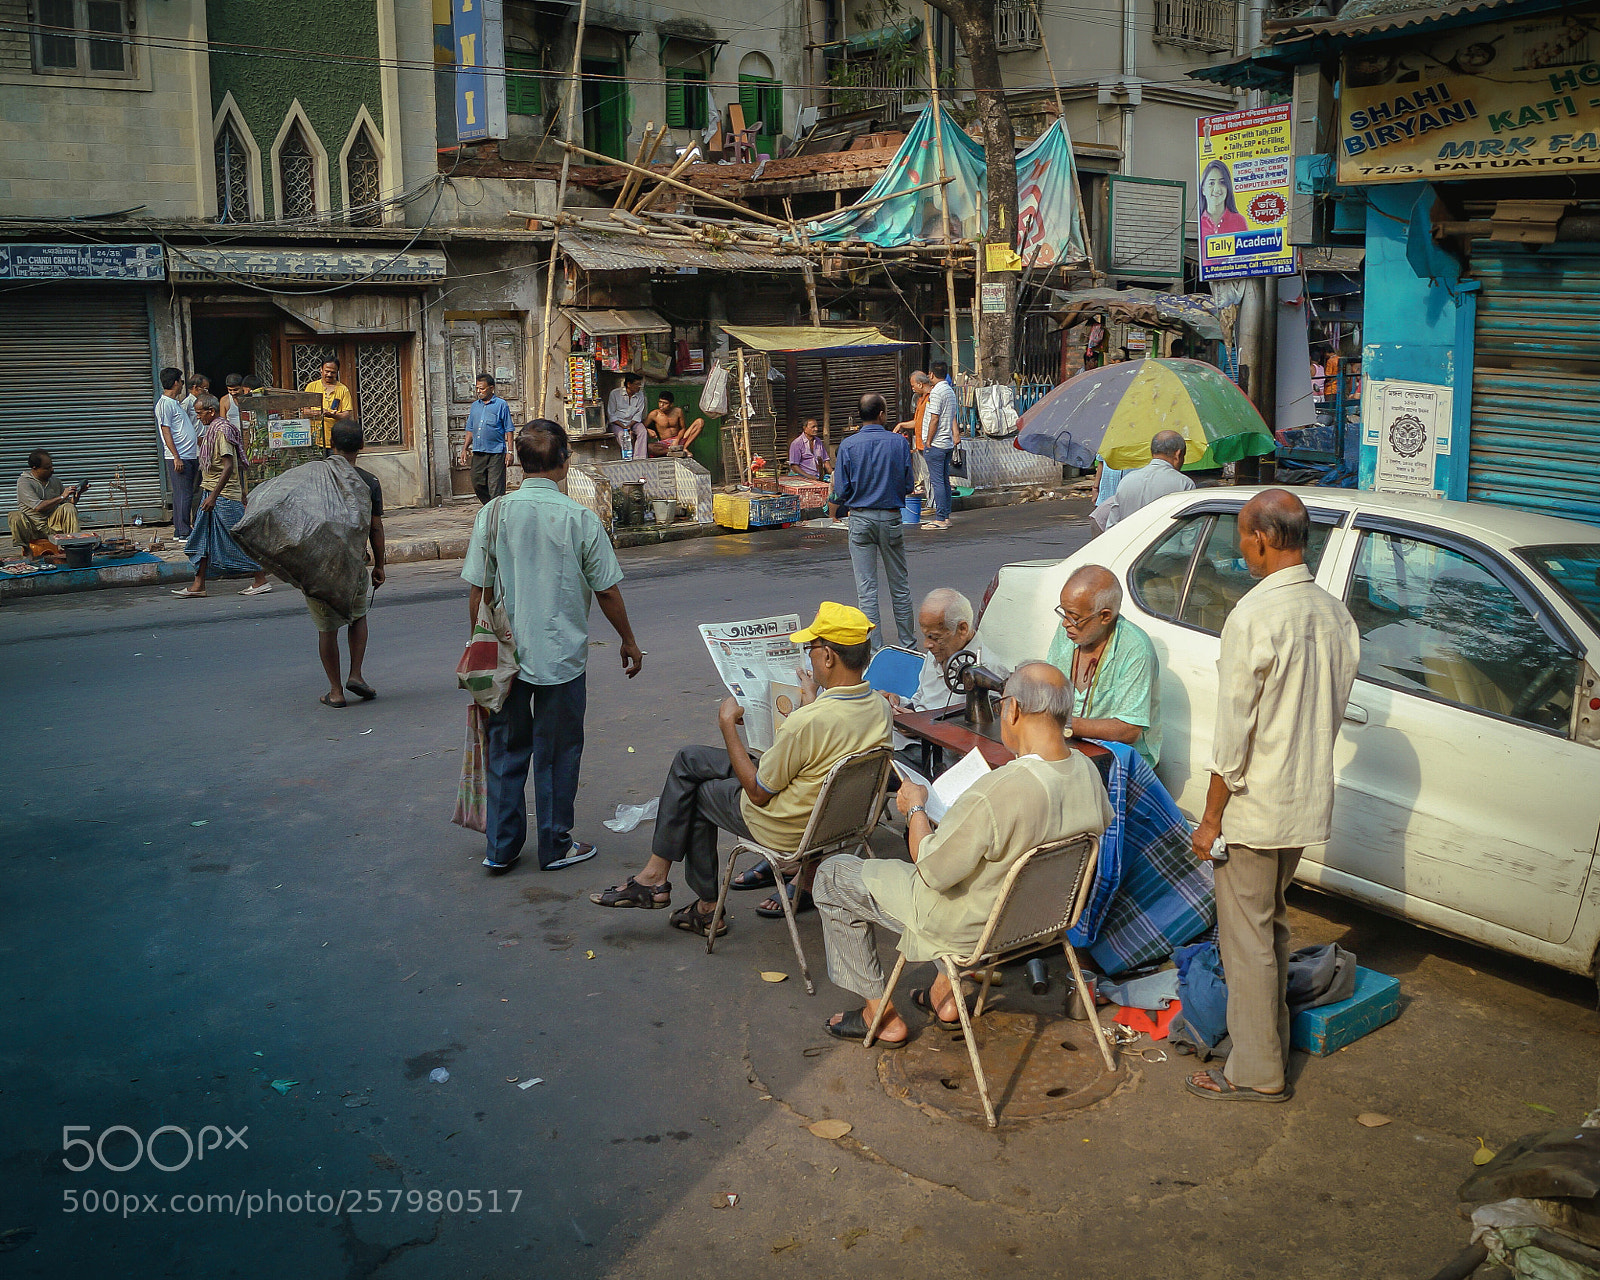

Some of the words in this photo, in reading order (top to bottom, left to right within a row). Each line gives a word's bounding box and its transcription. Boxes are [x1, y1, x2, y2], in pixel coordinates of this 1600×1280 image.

[1350, 83, 1451, 130] SHAHI
[1488, 96, 1578, 134] KATI
[1344, 99, 1478, 155] BIRYANI
[1229, 132, 1241, 142] GST
[1437, 136, 1536, 160] MRK
[1548, 132, 1600, 152] FA
[1223, 153, 1235, 161] GST
[1359, 165, 1424, 175] 72/3,
[1434, 155, 1600, 171] PATUATOL
[1234, 180, 1270, 190] COMPUTER
[1210, 240, 1232, 251] Tally
[1235, 235, 1282, 249] Academy
[720, 621, 778, 638] আজকাল
